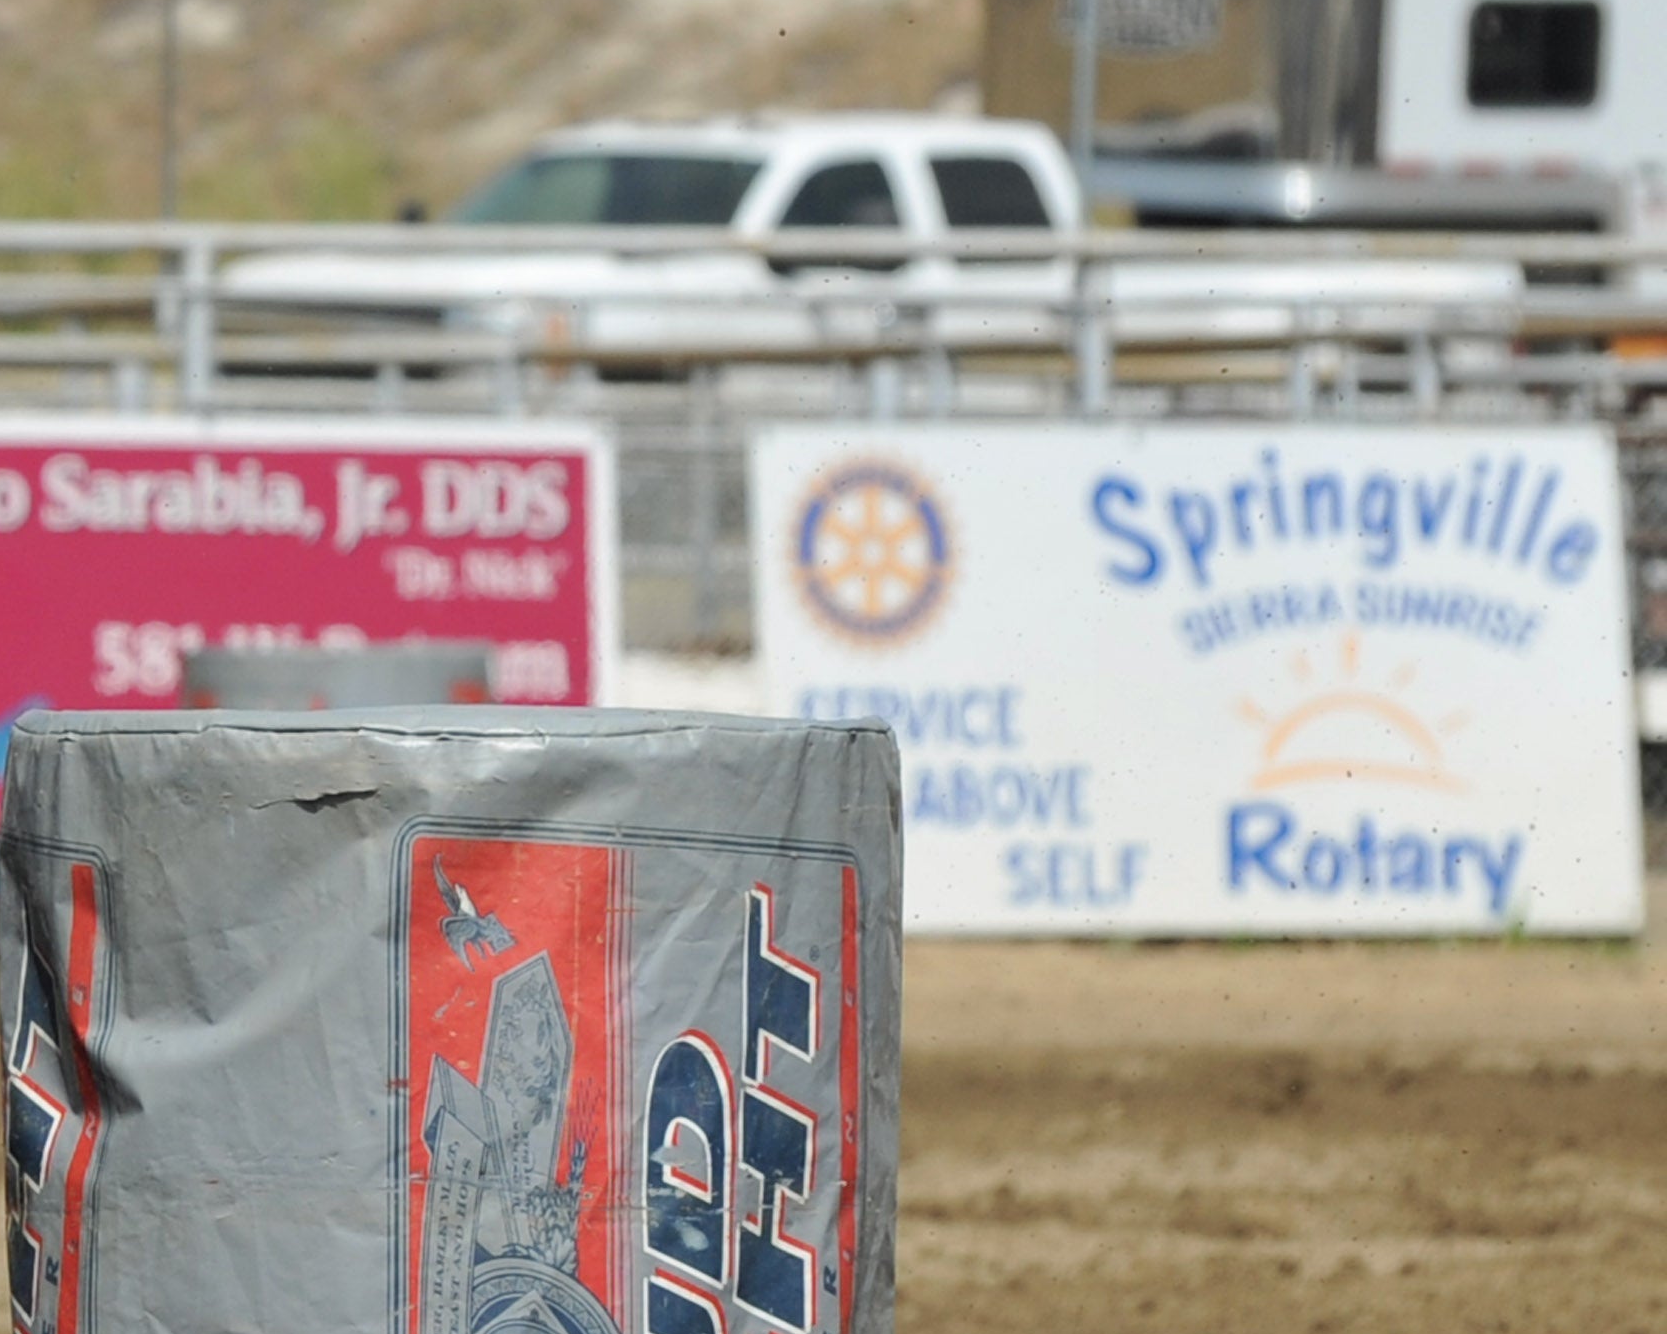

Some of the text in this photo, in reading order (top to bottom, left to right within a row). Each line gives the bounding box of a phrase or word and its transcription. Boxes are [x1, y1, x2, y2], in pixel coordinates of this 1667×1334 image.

[40, 451, 326, 541] Sarabia,
[333, 459, 410, 551] Jr.
[420, 458, 571, 540] DDS
[1090, 448, 1601, 589] Springville
[1176, 578, 1547, 657] SIERRA SUNRISE
[913, 764, 1093, 827] ABOVE
[1008, 840, 1148, 908] SELF
[1225, 799, 1527, 915] Rotary
